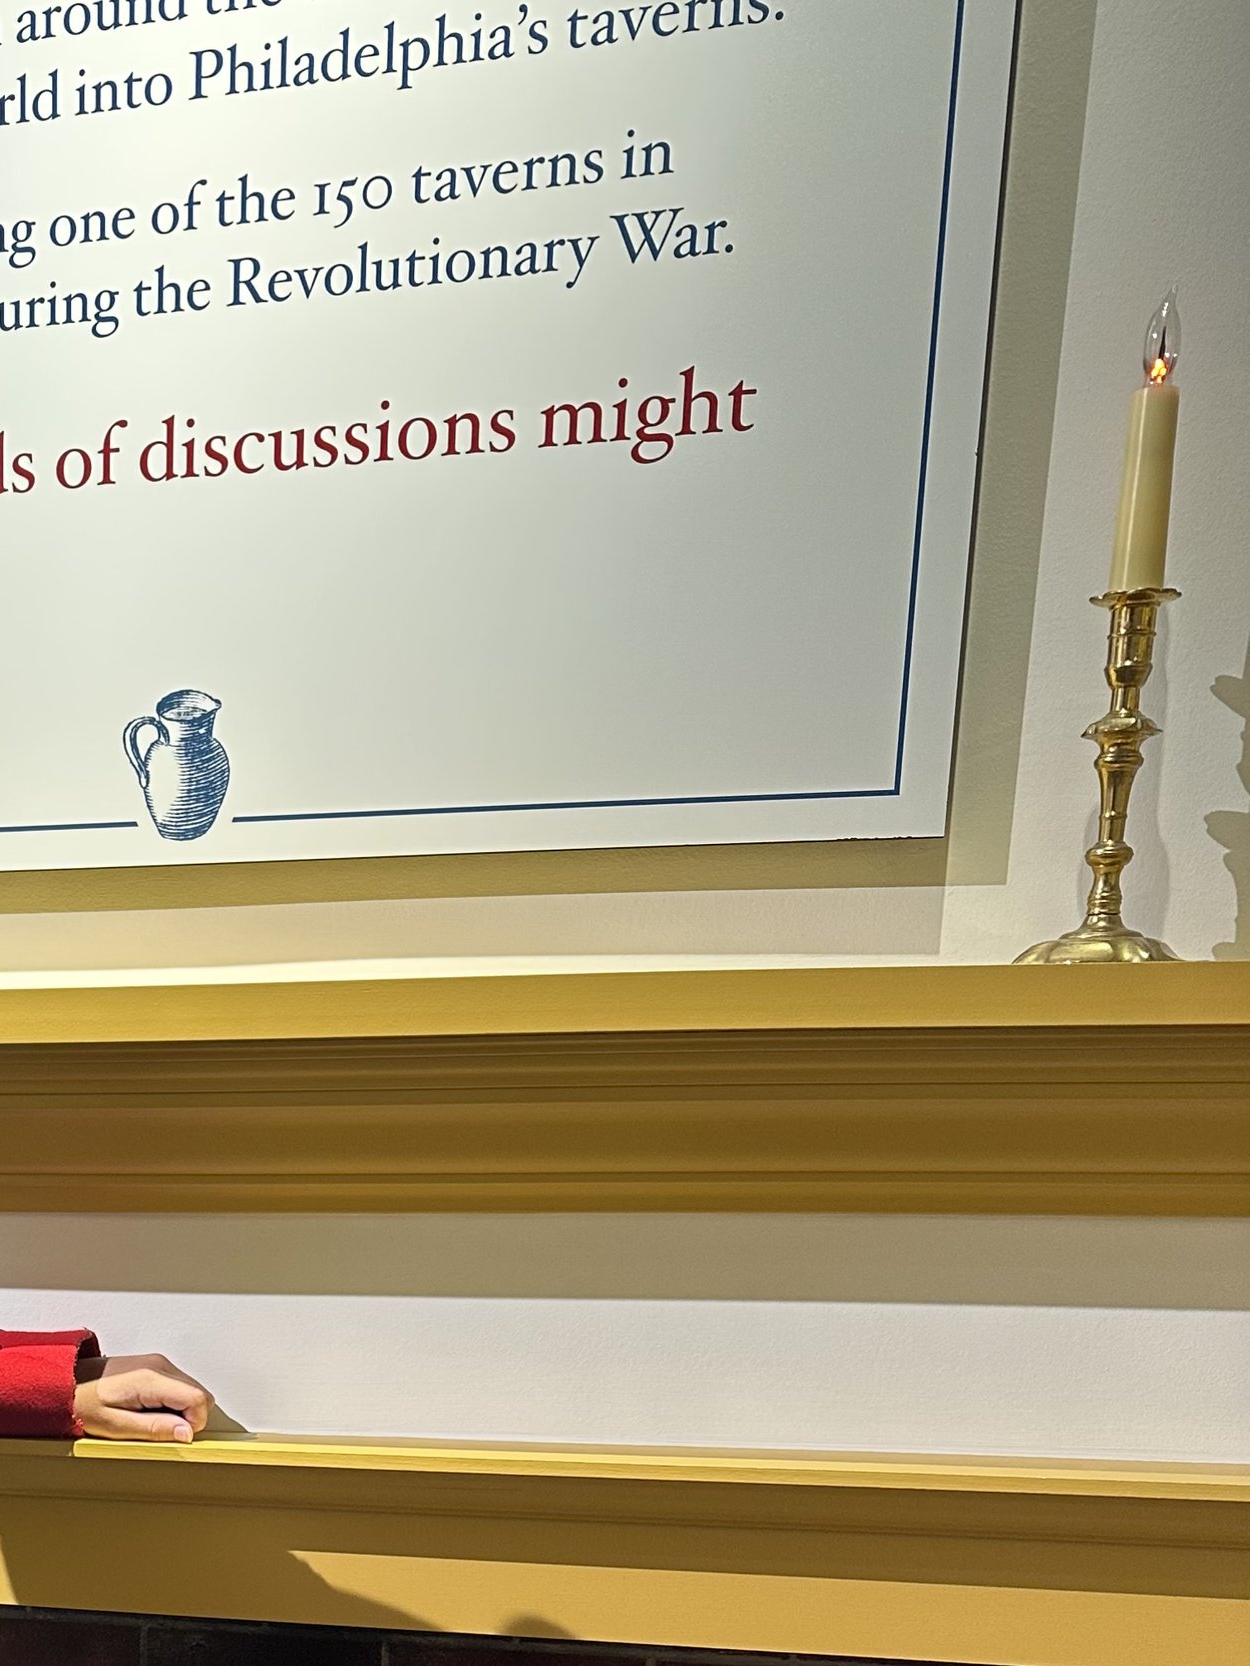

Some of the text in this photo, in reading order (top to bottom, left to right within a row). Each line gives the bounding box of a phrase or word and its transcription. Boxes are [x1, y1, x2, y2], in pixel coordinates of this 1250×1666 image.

[74, 69, 173, 117] into
[187, 13, 549, 101] Philadelphia’s
[566, 0, 785, 49] taverns.
[48, 207, 136, 248] one
[150, 179, 208, 235] of
[214, 173, 296, 228] the
[312, 176, 393, 229] 150
[411, 150, 605, 206] taverns
[617, 129, 675, 181] in
[132, 264, 212, 317] the
[225, 235, 601, 308] Revolutionary
[608, 207, 734, 265] War.
[55, 420, 129, 490] of
[138, 399, 517, 483] discussions
[536, 364, 758, 465] might
